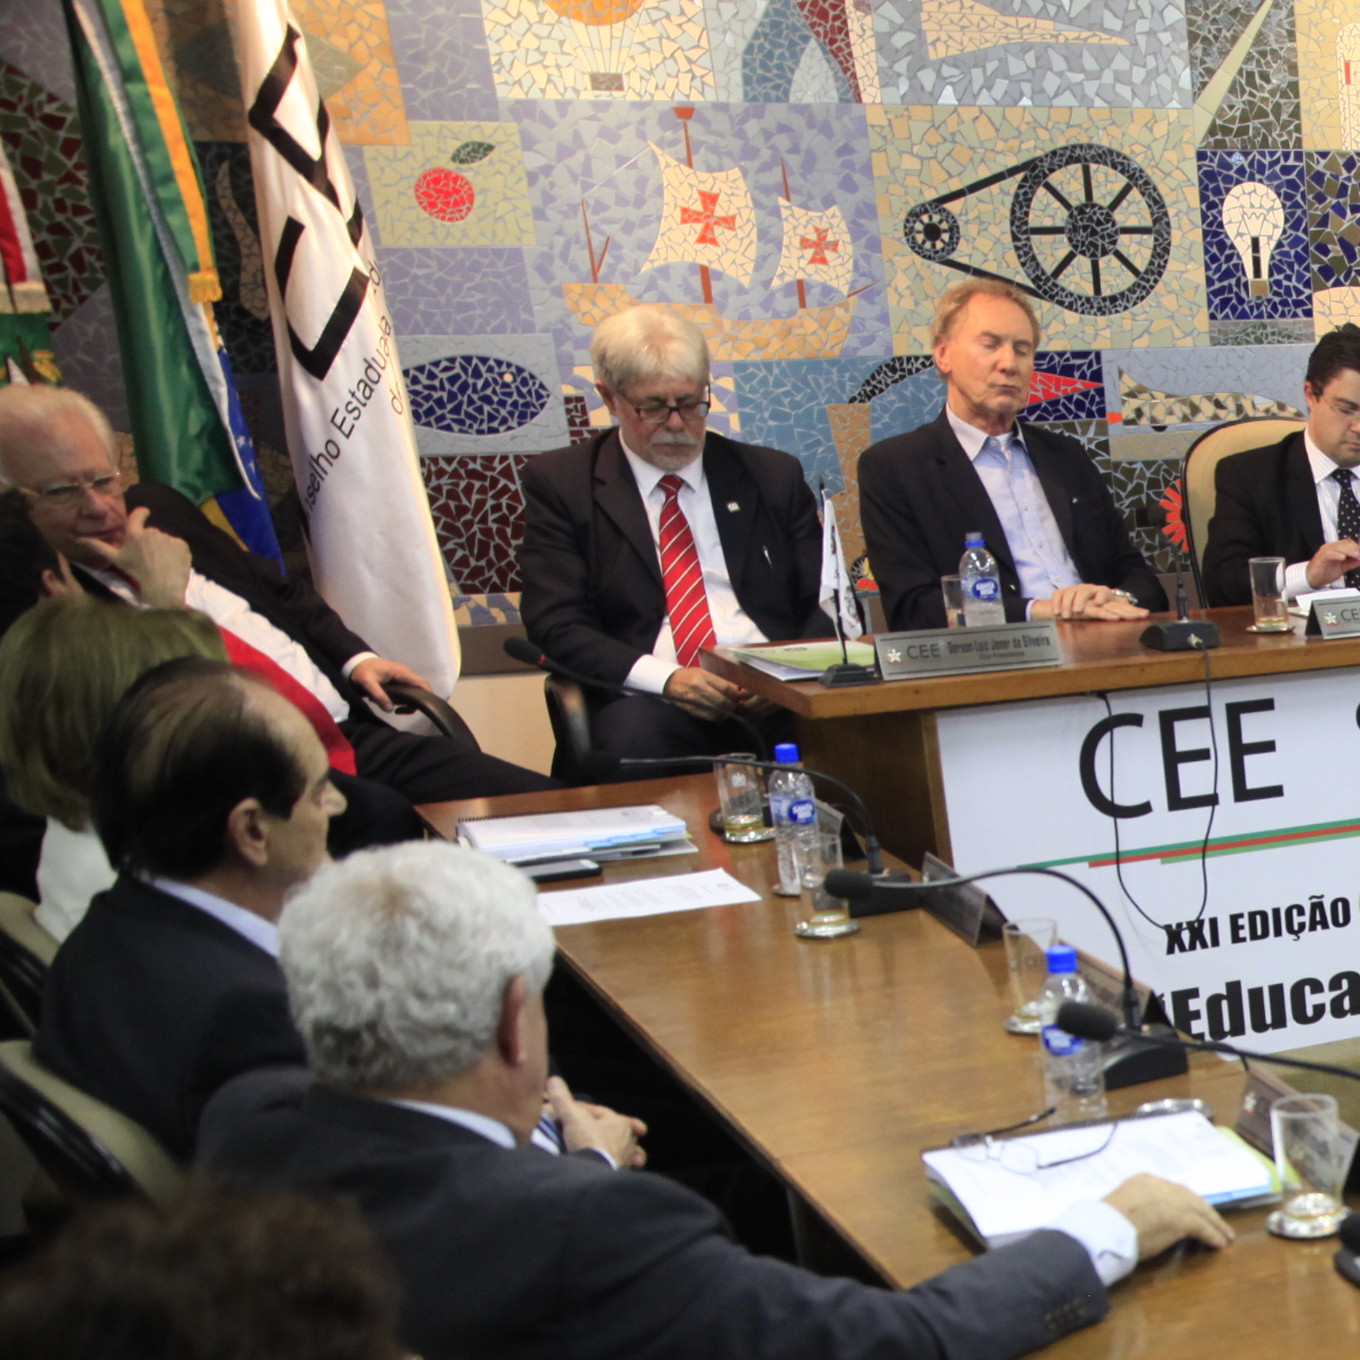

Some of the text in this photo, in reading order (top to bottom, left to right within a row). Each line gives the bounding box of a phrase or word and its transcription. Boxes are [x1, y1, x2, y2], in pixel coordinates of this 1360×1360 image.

[907, 643, 941, 660] CEE
[1079, 698, 1285, 819] CEE
[1165, 915, 1219, 955] XXI
[1230, 894, 1352, 945] EDIÇÃO
